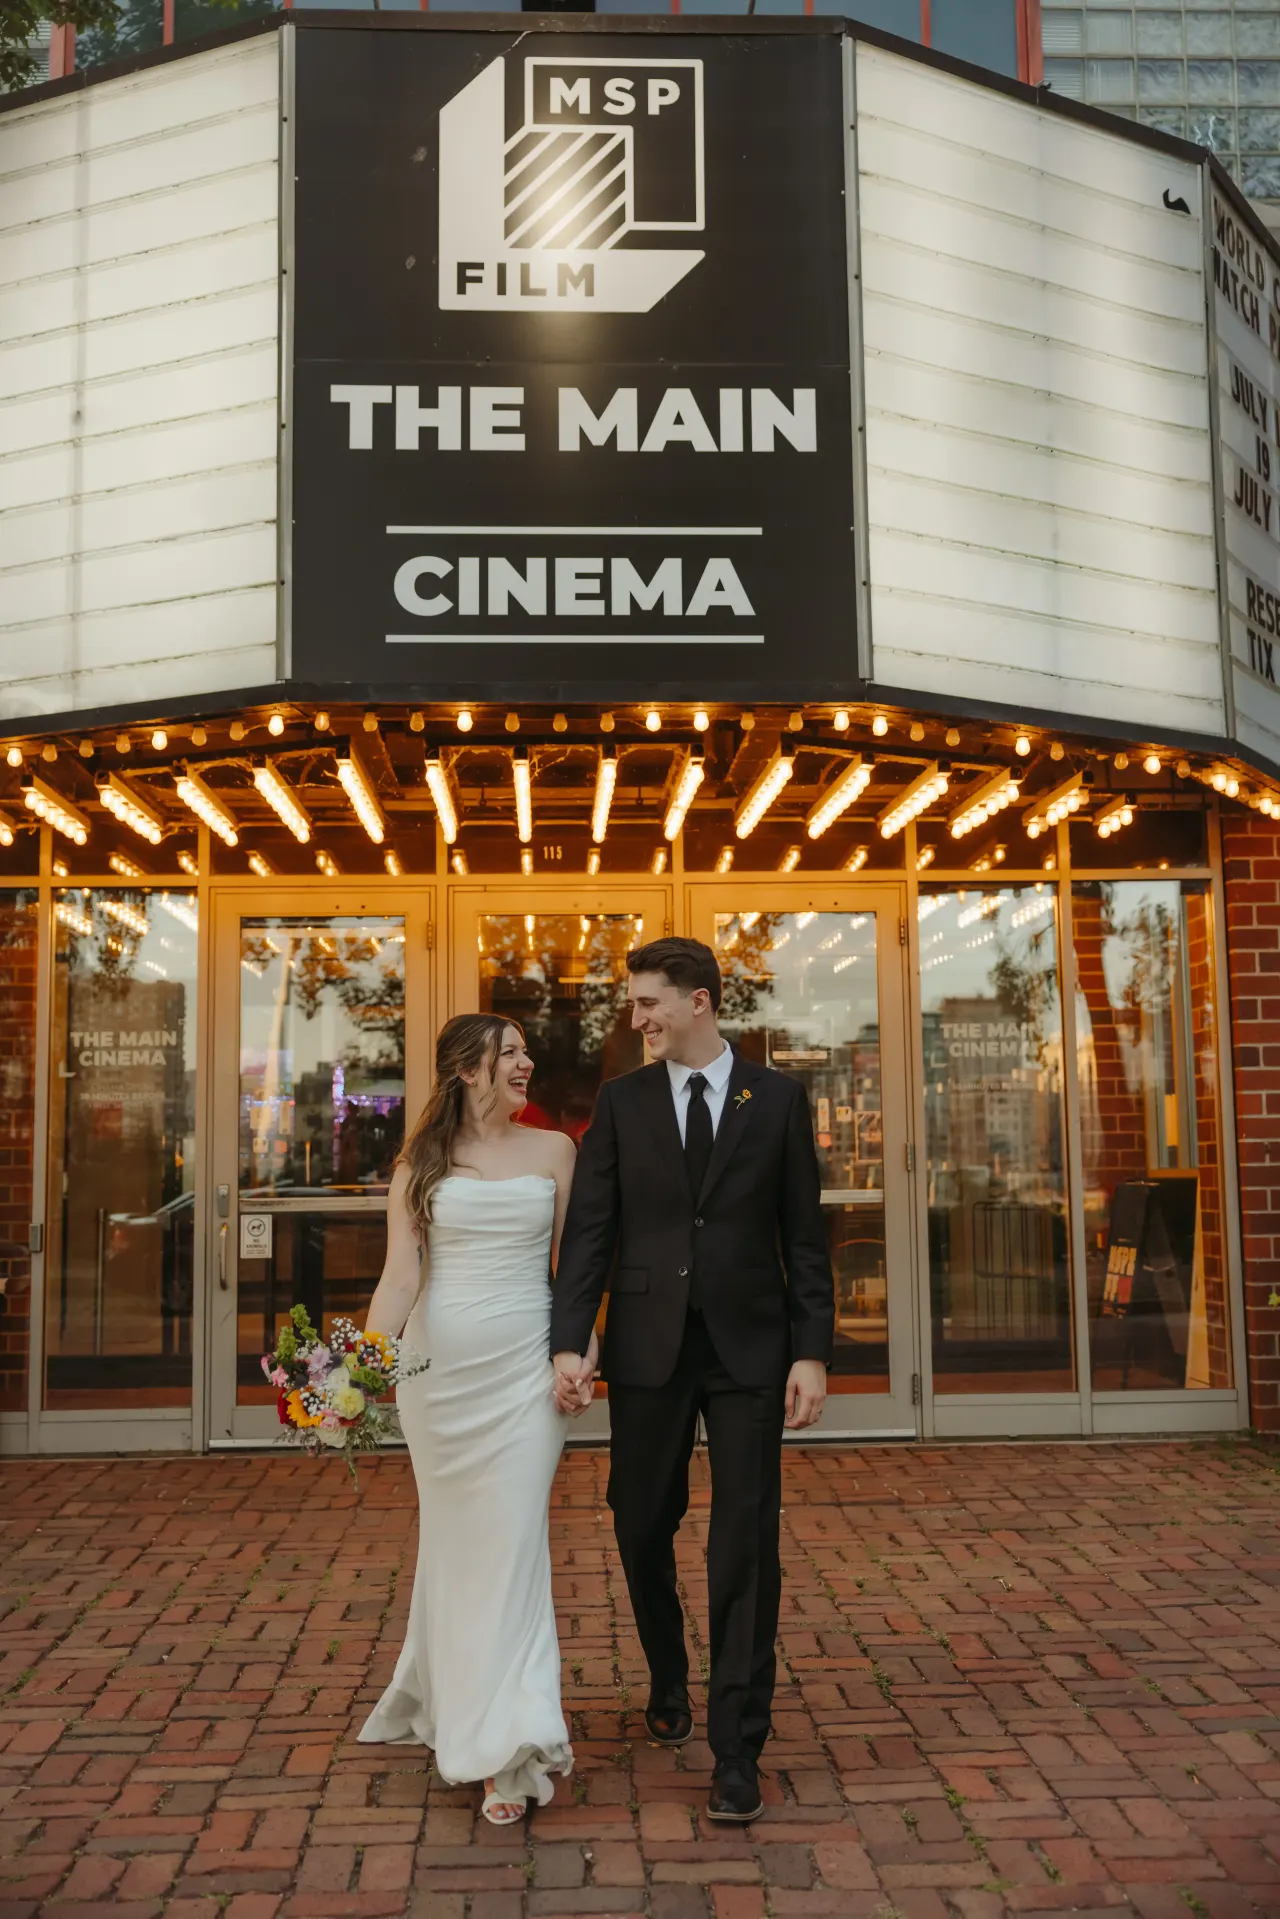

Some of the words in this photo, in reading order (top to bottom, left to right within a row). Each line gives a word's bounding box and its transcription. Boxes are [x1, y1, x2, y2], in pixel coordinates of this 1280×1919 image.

[549, 77, 681, 116] MSP
[1213, 197, 1265, 292] WORLD
[456, 261, 595, 297] FILM
[330, 384, 526, 451] THE
[558, 387, 817, 452] MAIN
[1231, 364, 1267, 433] JULY
[1255, 435, 1270, 482] 19
[1234, 467, 1271, 532] JULY
[393, 555, 756, 616] CINEMA
[1246, 627, 1275, 683] TIX
[543, 845, 562, 860] 115
[69, 1031, 114, 1047] THE
[119, 1030, 177, 1046] MAIN
[939, 1022, 982, 1039] THE
[79, 1049, 167, 1067] CINEMA
